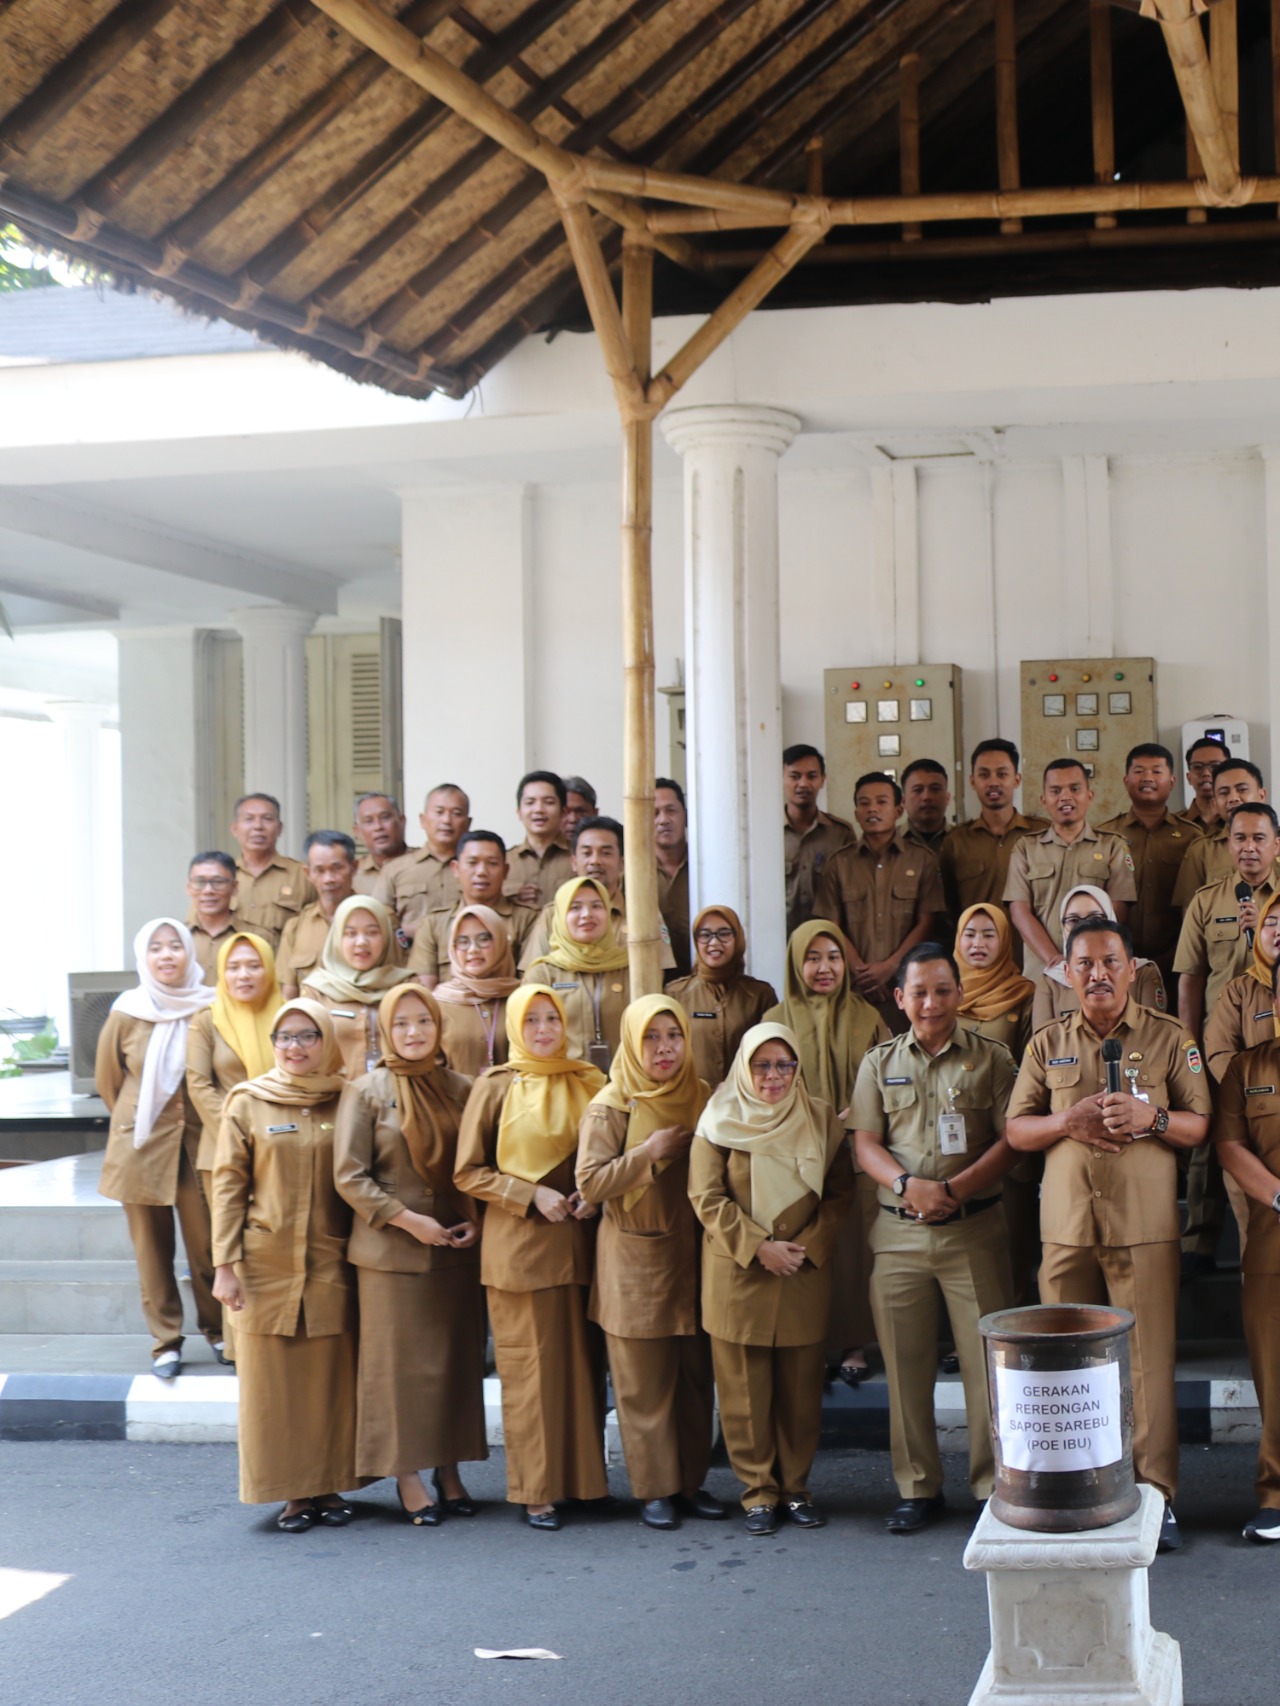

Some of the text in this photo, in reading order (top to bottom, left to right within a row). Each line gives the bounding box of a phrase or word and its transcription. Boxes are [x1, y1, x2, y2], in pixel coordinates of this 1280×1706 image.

[1023, 1384, 1090, 1397] GERAKAN
[1016, 1400, 1100, 1415] REREONGAN
[1010, 1416, 1109, 1433] SAPOE SAREBU
[1028, 1437, 1092, 1453] (POE IBU)
